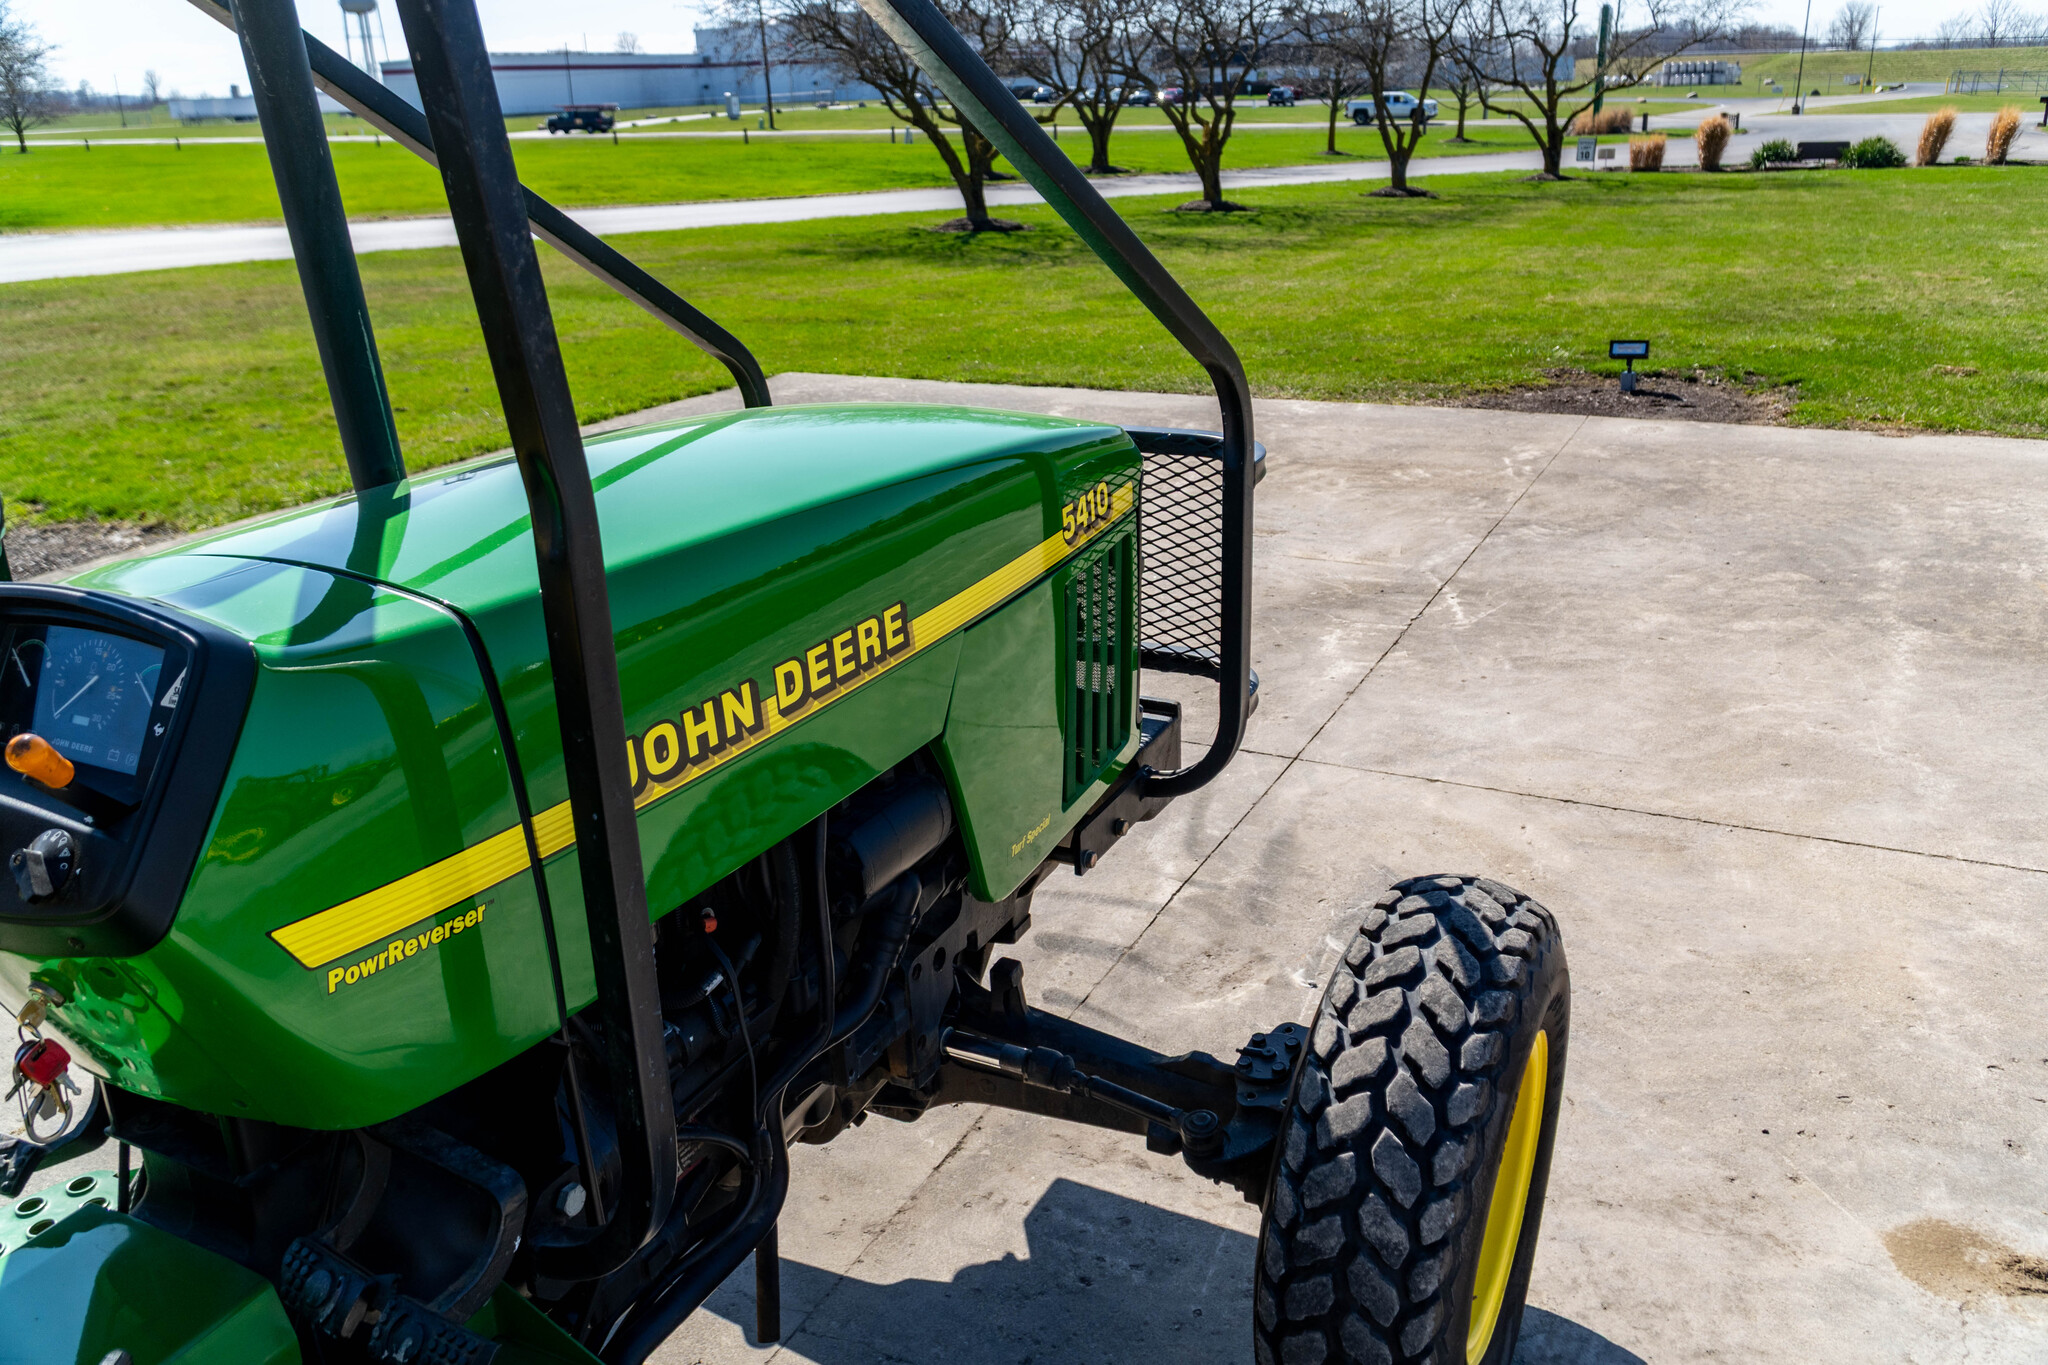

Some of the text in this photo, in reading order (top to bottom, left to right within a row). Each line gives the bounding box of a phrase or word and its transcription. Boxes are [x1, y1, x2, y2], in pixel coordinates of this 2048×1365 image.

[1580, 151, 1590, 159] 10
[1062, 481, 1110, 545] 5410
[106, 663, 117, 672] 20
[626, 601, 909, 796] JOHN DEERE
[51, 737, 94, 754] JOHN DEERE
[1011, 813, 1051, 858] Turf Special
[327, 903, 487, 996] PowrReverser
